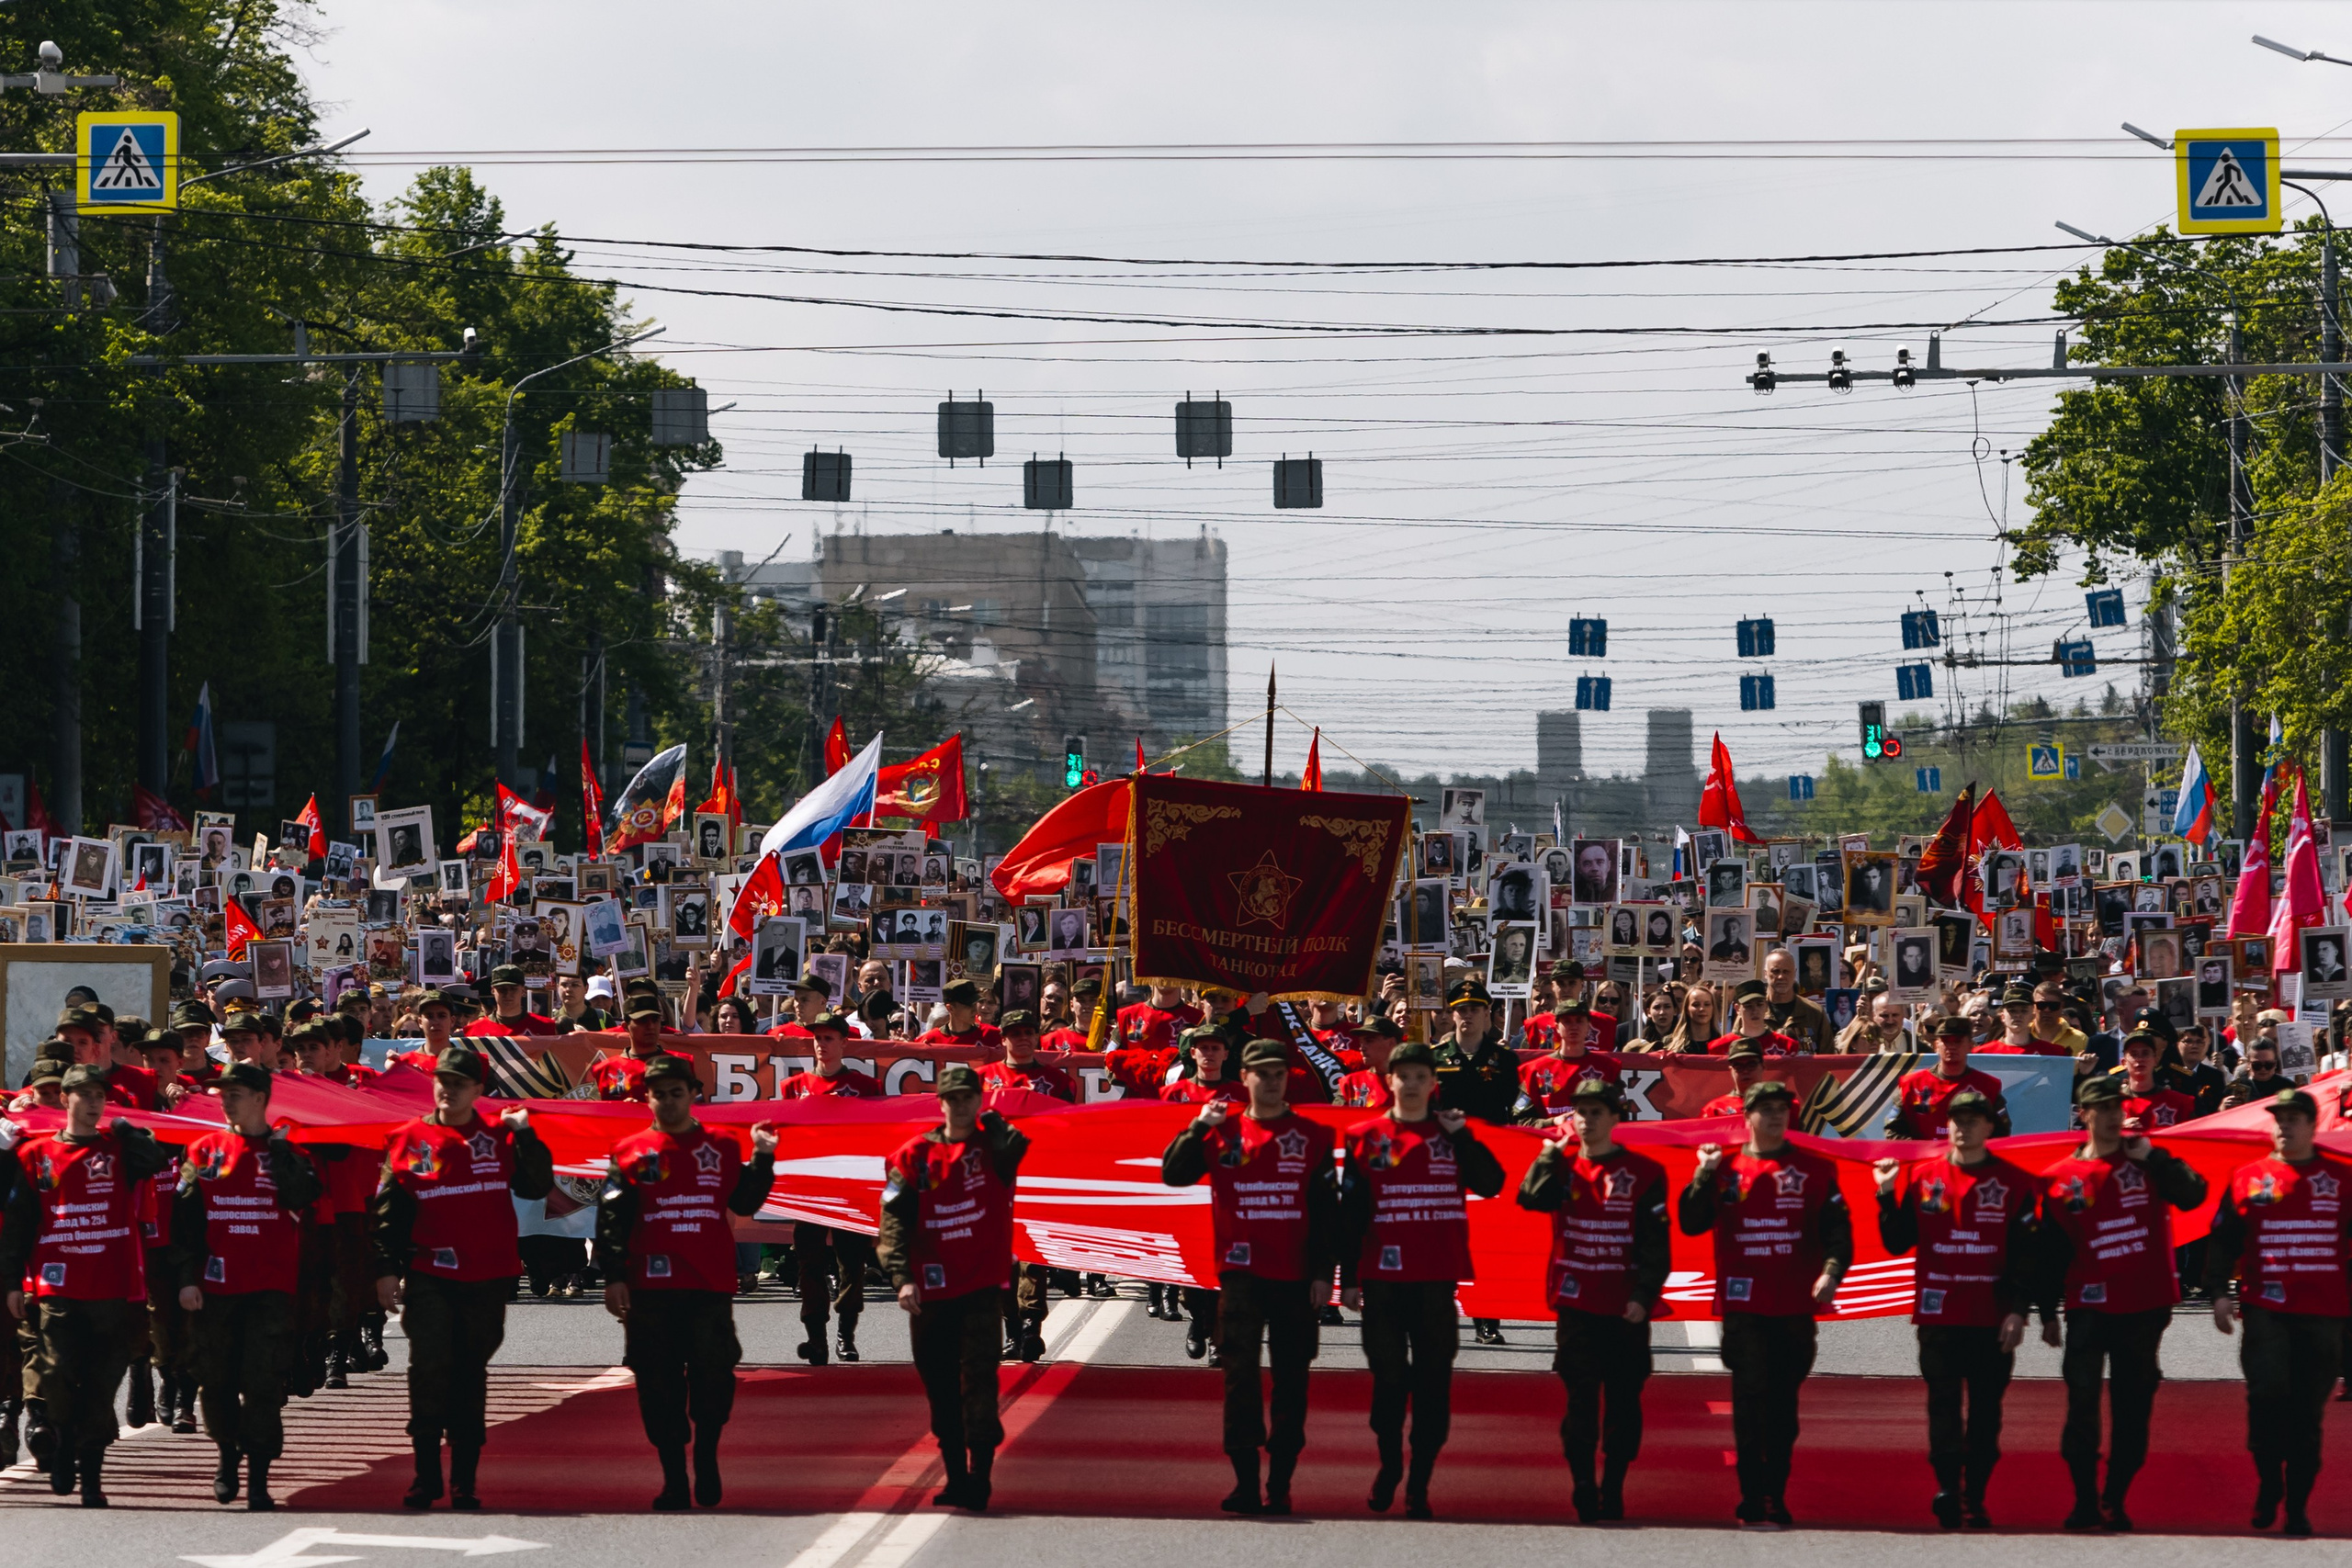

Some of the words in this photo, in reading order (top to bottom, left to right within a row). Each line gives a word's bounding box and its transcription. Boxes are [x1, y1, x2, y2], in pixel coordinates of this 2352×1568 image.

[2107, 746, 2178, 757] СВЕРДЛОВСК
[1153, 919, 1299, 954] БЕССМЕРТНЫЙ
[1303, 936, 1351, 953] ПОЛК
[1295, 1032, 1345, 1090] ТАНКО
[415, 1181, 482, 1200] агайбакский
[1233, 1180, 1300, 1193] Челябинский
[212, 1195, 273, 1206] Челябинский
[1238, 1195, 1268, 1206] завод
[52, 1217, 78, 1229] авод
[91, 1214, 107, 1225] 254
[228, 1225, 260, 1235] завод
[671, 1223, 701, 1234] завод
